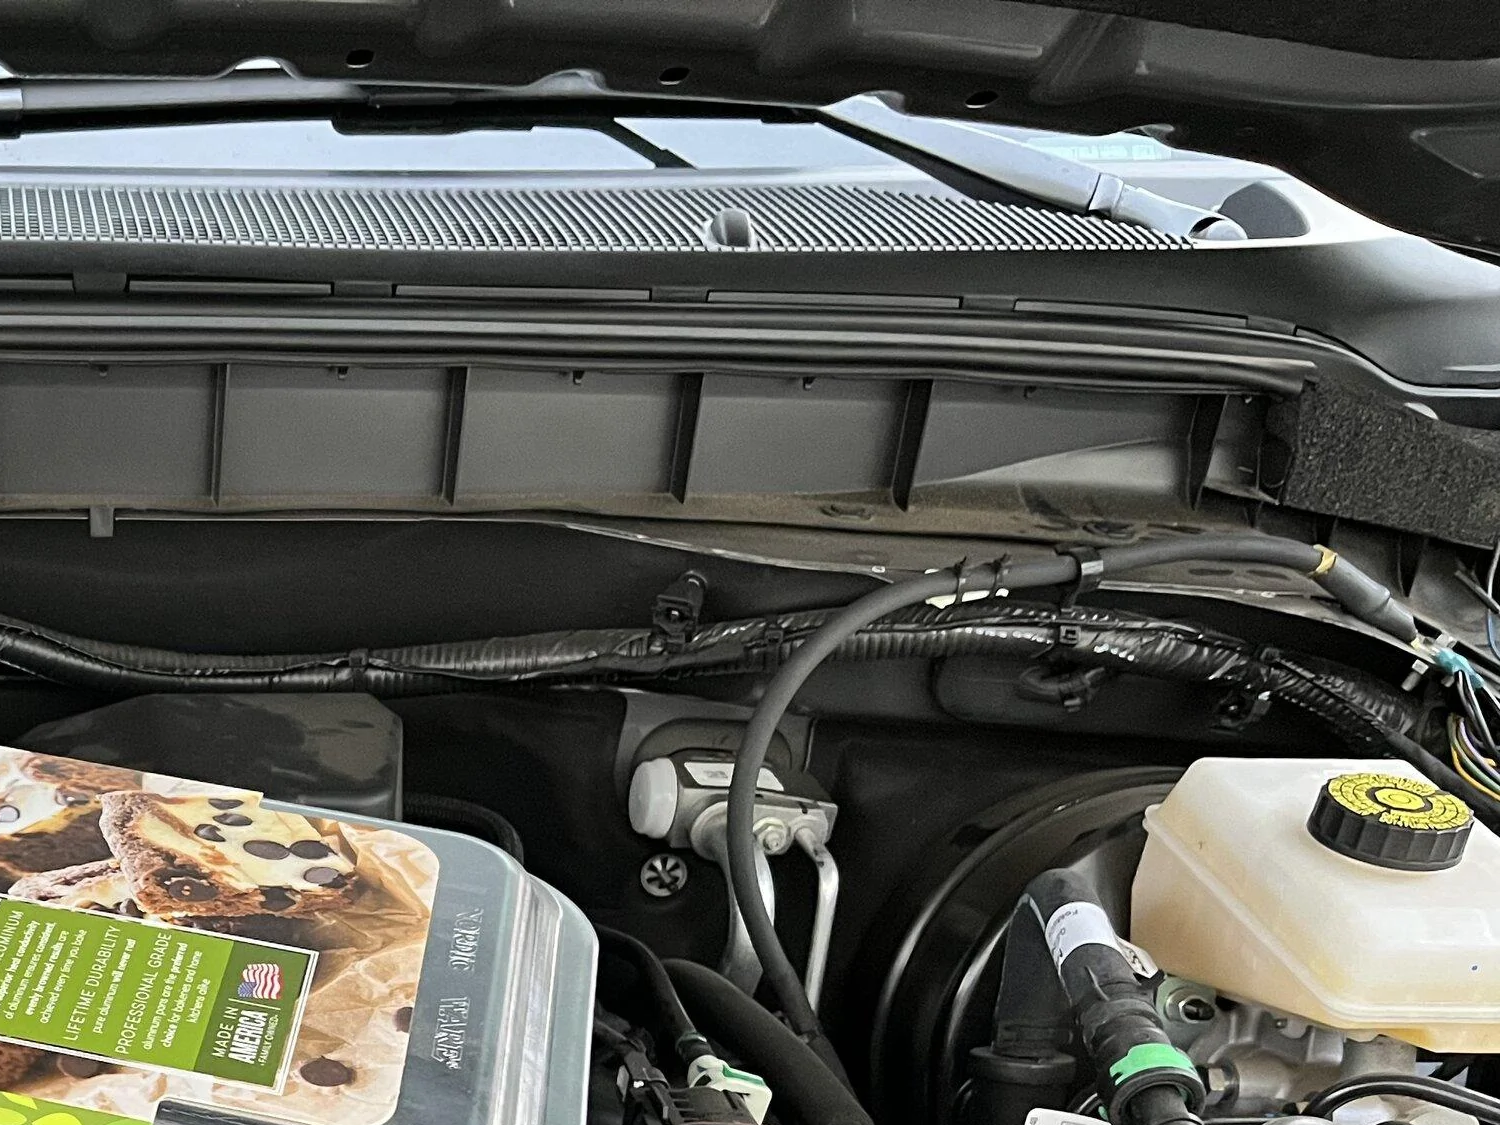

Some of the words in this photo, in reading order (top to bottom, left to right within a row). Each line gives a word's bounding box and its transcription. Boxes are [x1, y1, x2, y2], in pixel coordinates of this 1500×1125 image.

[70, 928, 88, 946] bake
[68, 945, 80, 958] you
[117, 950, 131, 971] never
[185, 950, 203, 969] home
[4, 956, 22, 973] heat
[7, 977, 30, 1011] aluminum
[23, 952, 42, 978] ensures
[31, 961, 55, 992] browned
[52, 972, 70, 992] every
[61, 988, 96, 1041] LIFETIME
[84, 924, 121, 987] DURABILITY
[163, 972, 178, 984] the
[184, 967, 197, 983] and
[96, 982, 119, 1016] aluminum
[113, 971, 159, 1054] PROFESSIONAL
[146, 931, 172, 968] GRADE
[161, 984, 174, 998] are
[37, 990, 60, 1024] achieved
[155, 997, 169, 1016] pans
[185, 995, 206, 1023] kitchens
[222, 1005, 239, 1019] IN
[92, 1015, 106, 1034] pure
[166, 1011, 181, 1023] for
[141, 1015, 162, 1050] aluminum
[159, 1023, 178, 1048] choice
[210, 1022, 235, 1058] MADE
[225, 1007, 270, 1065] AMERICA
